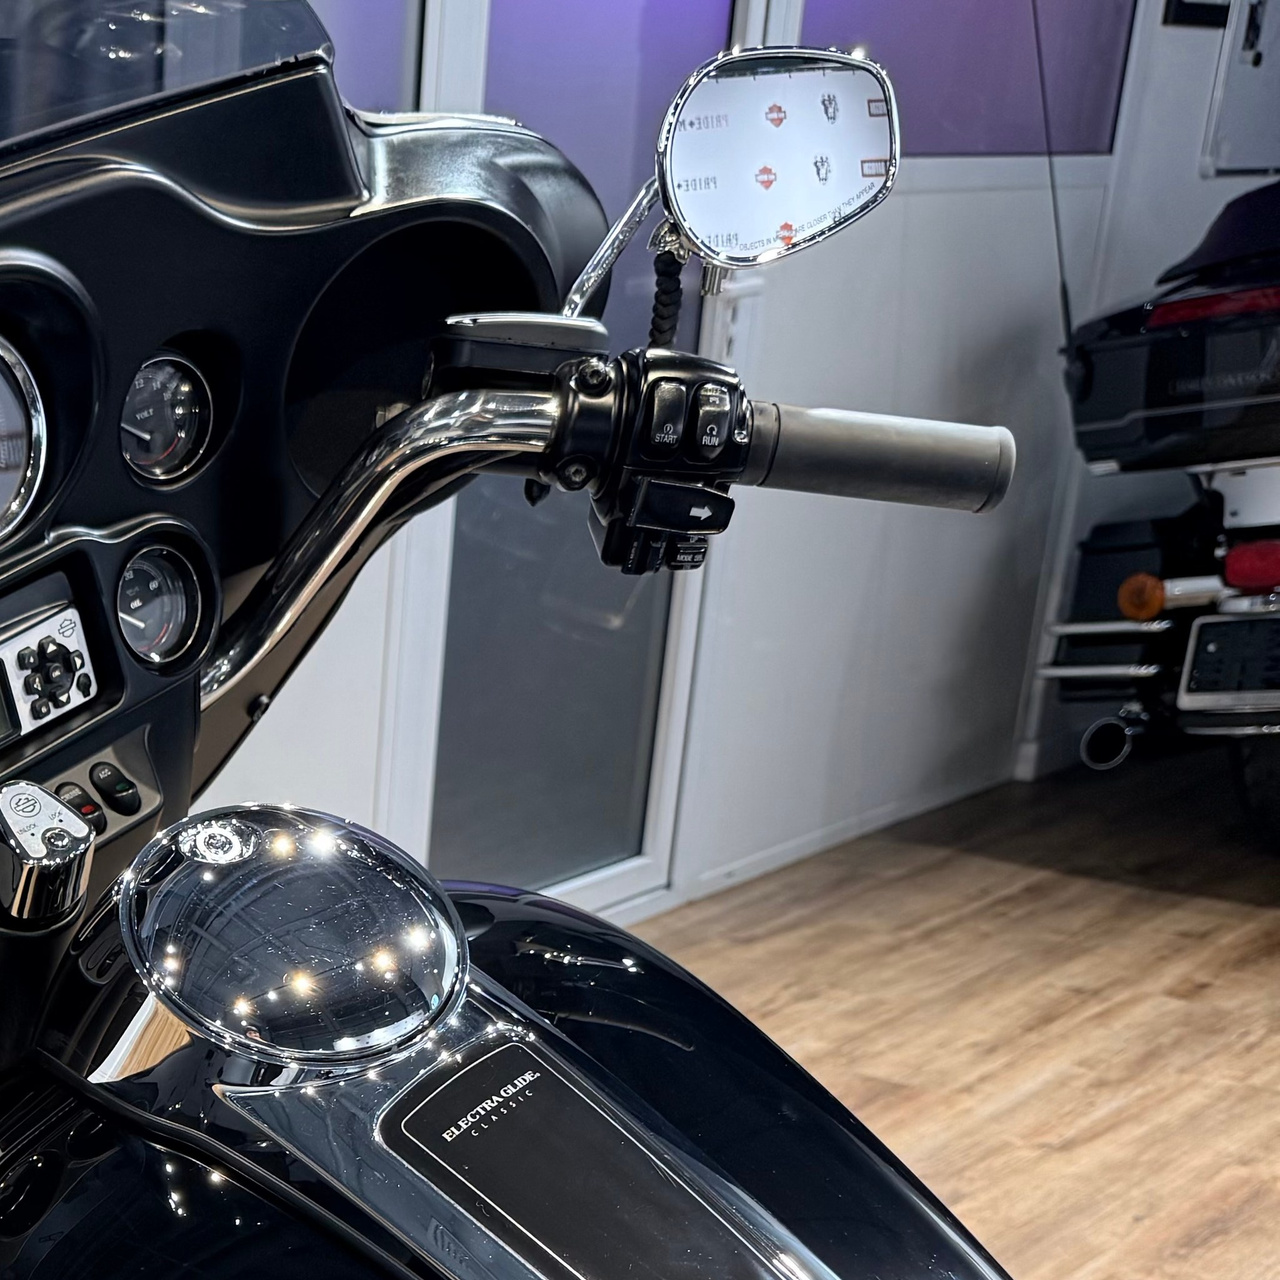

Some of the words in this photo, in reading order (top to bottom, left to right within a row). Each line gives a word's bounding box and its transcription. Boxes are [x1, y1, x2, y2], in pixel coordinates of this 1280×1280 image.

[739, 239, 765, 251] OBJECTS
[135, 407, 154, 420] VOLT
[654, 434, 678, 445] START
[702, 435, 719, 447] RUN
[130, 598, 143, 610] OIL
[441, 1095, 504, 1142] ELECTRA
[500, 1070, 539, 1097] GLIDE
[471, 1089, 533, 1136] CLASSIC
